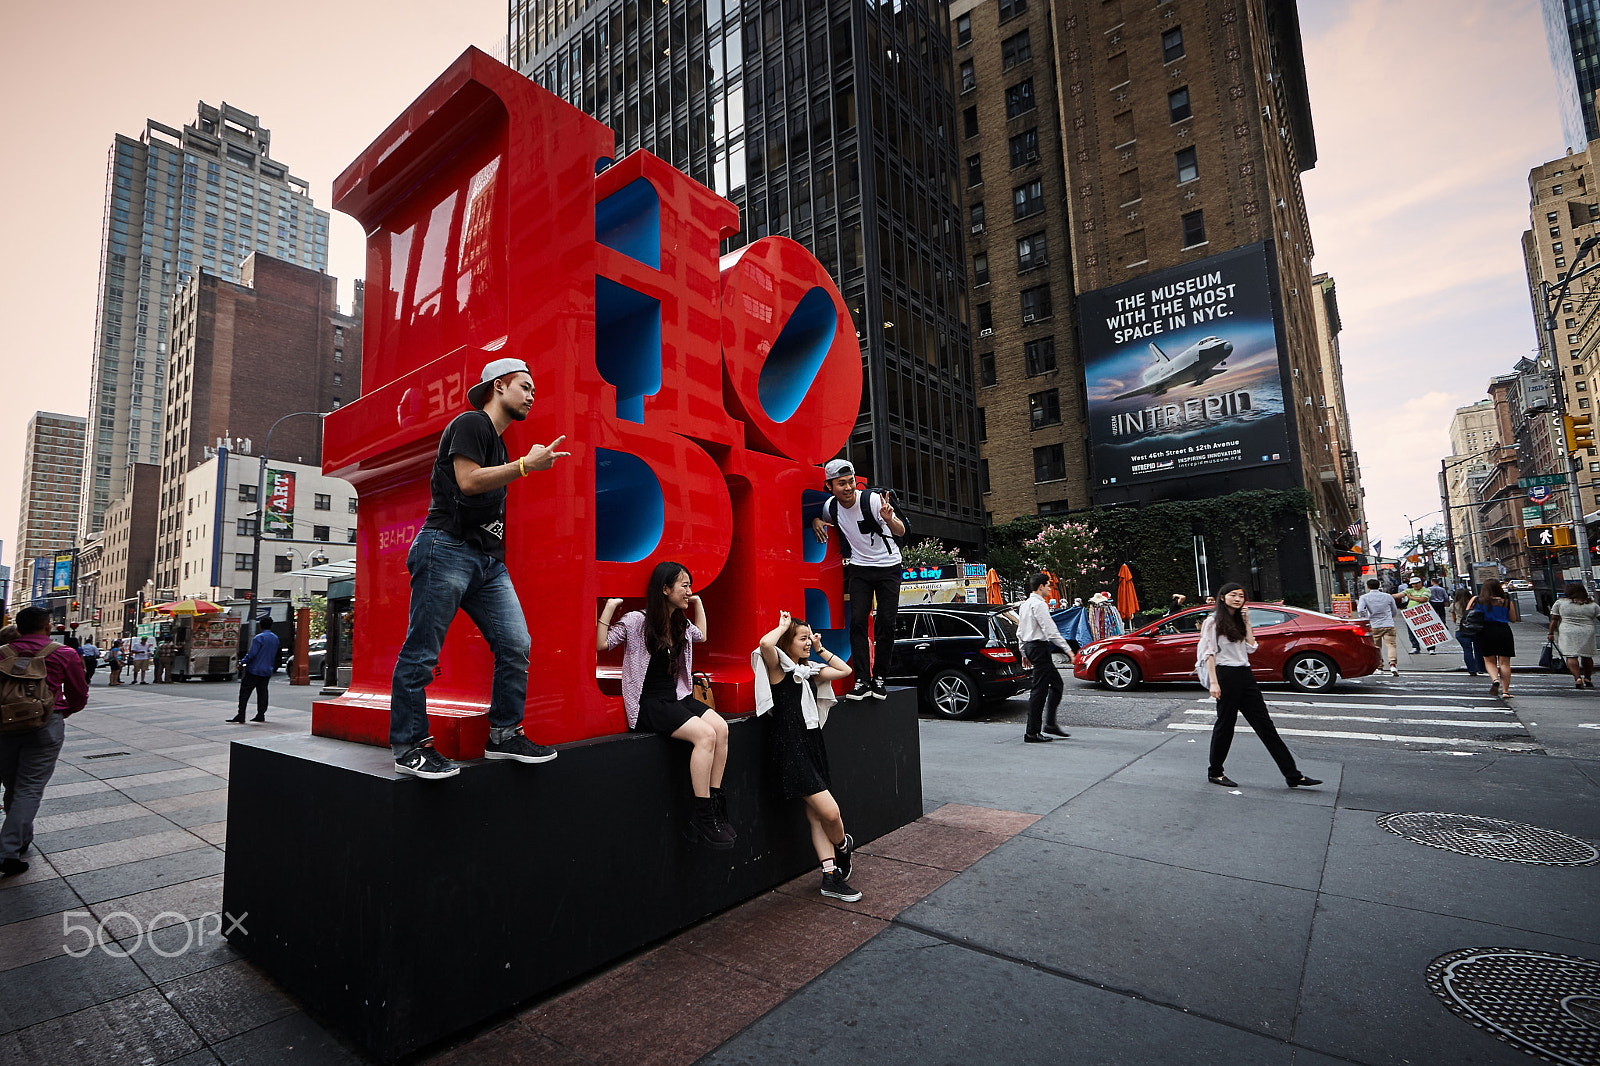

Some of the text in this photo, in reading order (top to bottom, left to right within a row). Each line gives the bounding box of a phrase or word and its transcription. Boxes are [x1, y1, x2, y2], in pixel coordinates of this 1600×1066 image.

[1115, 270, 1222, 312] THE MUSEUM
[1106, 283, 1236, 330] WITH THE MOST
[1114, 303, 1234, 344] SPACE IN NYC.
[1117, 389, 1253, 436] INTREPID
[1148, 451, 1165, 459] 46th
[1165, 448, 1187, 457] Street
[1195, 443, 1212, 452] 12th
[1212, 440, 1240, 449] Avenue
[1177, 448, 1242, 464] INSPIRING INNOVATION
[1540, 476, 1553, 485] 53
[273, 474, 289, 510] ART
[920, 569, 942, 580] day
[1415, 605, 1426, 614] OUT
[1424, 603, 1431, 612] OF
[1411, 613, 1434, 626] BUSINESS
[1414, 622, 1445, 638] EVERYTHING
[1422, 634, 1438, 646] MUST
